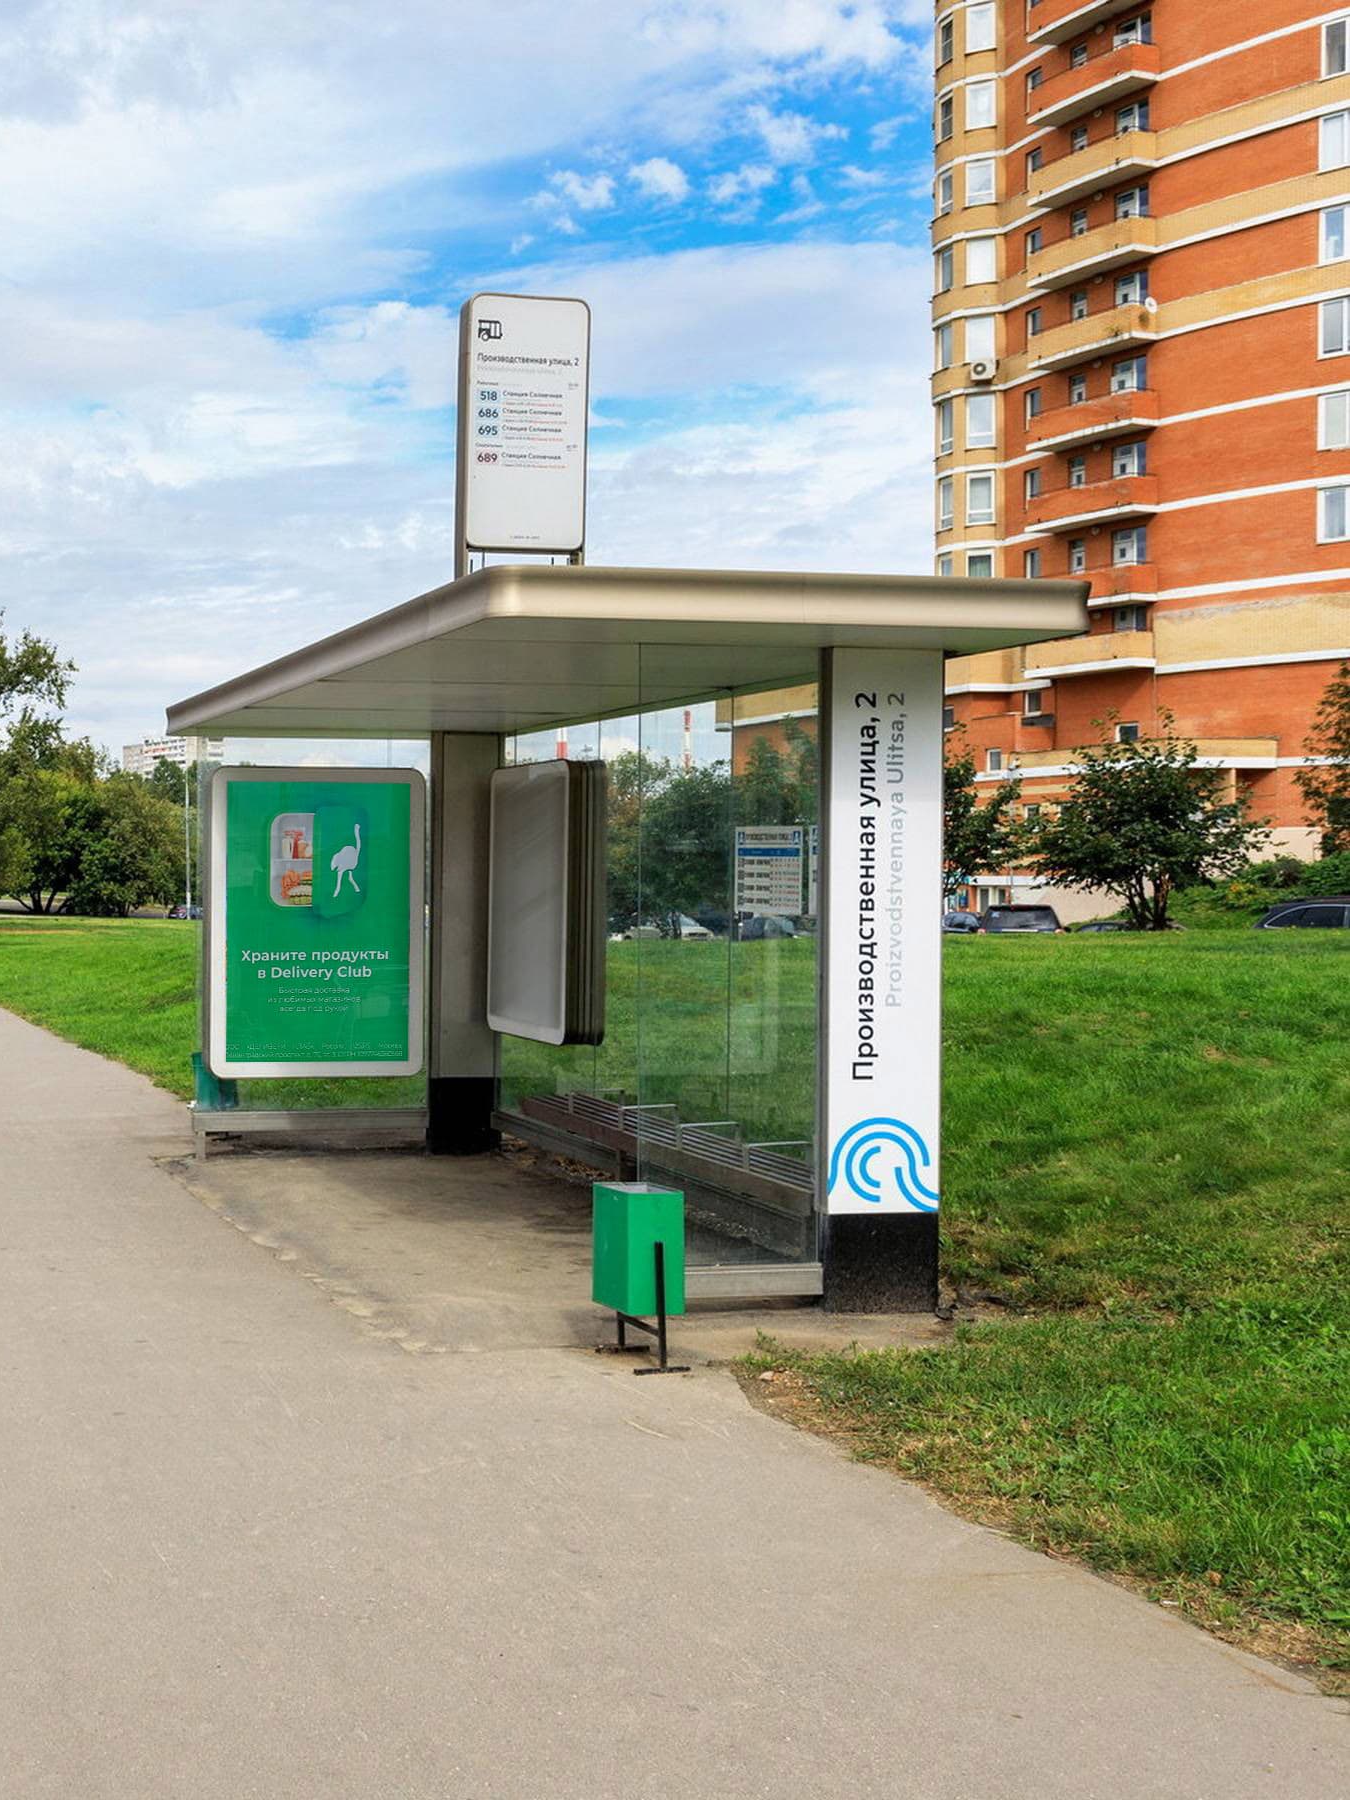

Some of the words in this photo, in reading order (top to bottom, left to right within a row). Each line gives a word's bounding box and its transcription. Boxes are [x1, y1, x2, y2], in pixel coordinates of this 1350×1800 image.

[477, 352, 547, 365] Производственная
[548, 358, 573, 367] улица,
[574, 358, 580, 366] 2
[480, 391, 498, 401] 518
[478, 408, 499, 418] 686
[478, 425, 498, 436] 695
[477, 453, 498, 463] 689
[855, 692, 877, 709] 2
[887, 692, 904, 706] 2
[886, 713, 908, 784] Ulitsa,
[857, 717, 881, 808] улица,
[885, 792, 907, 1008] Proizvodstvennaya
[851, 814, 878, 1081] Производственная
[241, 950, 307, 964] Храните
[311, 950, 389, 964] продукты
[257, 969, 266, 979] в
[271, 966, 333, 980] Delivery
[336, 965, 372, 978] Club
